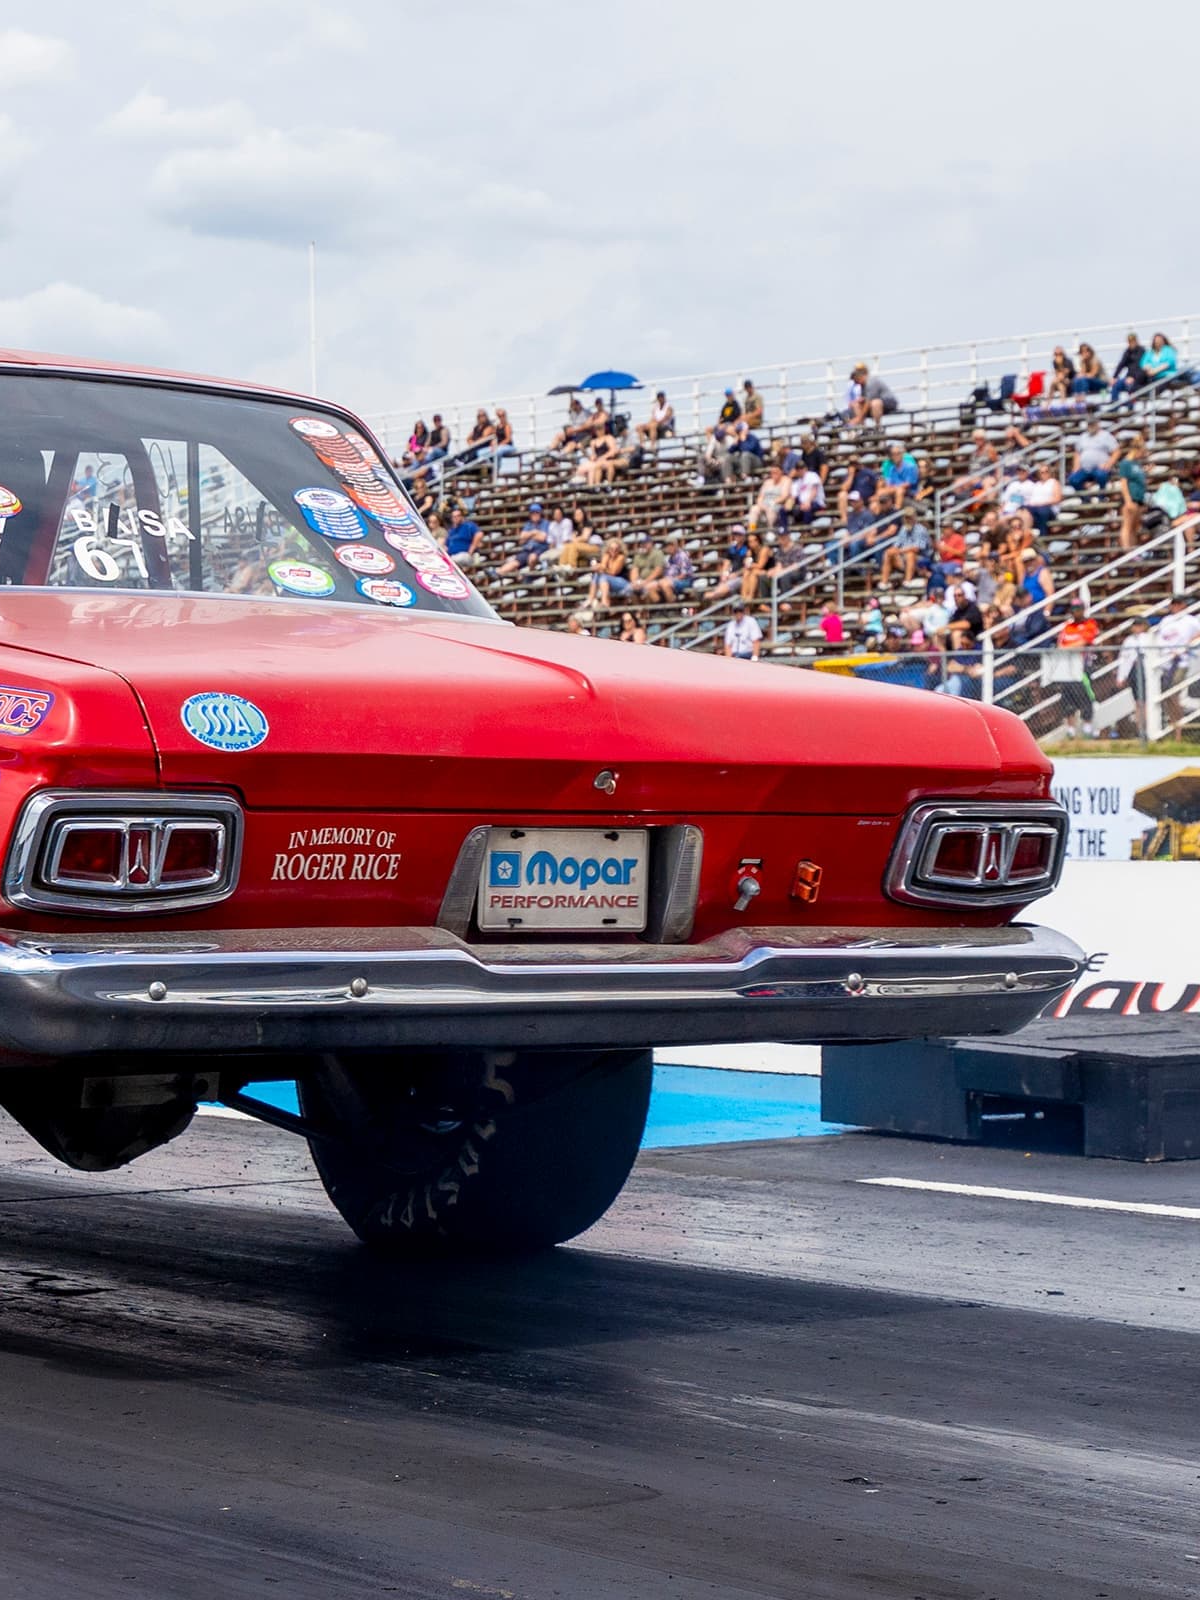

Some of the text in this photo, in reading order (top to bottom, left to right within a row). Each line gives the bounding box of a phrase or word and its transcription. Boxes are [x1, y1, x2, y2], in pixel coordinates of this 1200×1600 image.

[73, 536, 150, 582] 67
[197, 703, 256, 736] SSSA
[198, 733, 223, 748] SUPER
[224, 741, 249, 750] STOCK
[1088, 787, 1120, 815] YOU
[288, 827, 397, 850] IN MEMORY OF
[1077, 828, 1107, 857] THE
[271, 853, 401, 880] ROGER RICE
[526, 850, 639, 891] Mopar
[490, 895, 640, 909] PERFORMANCE
